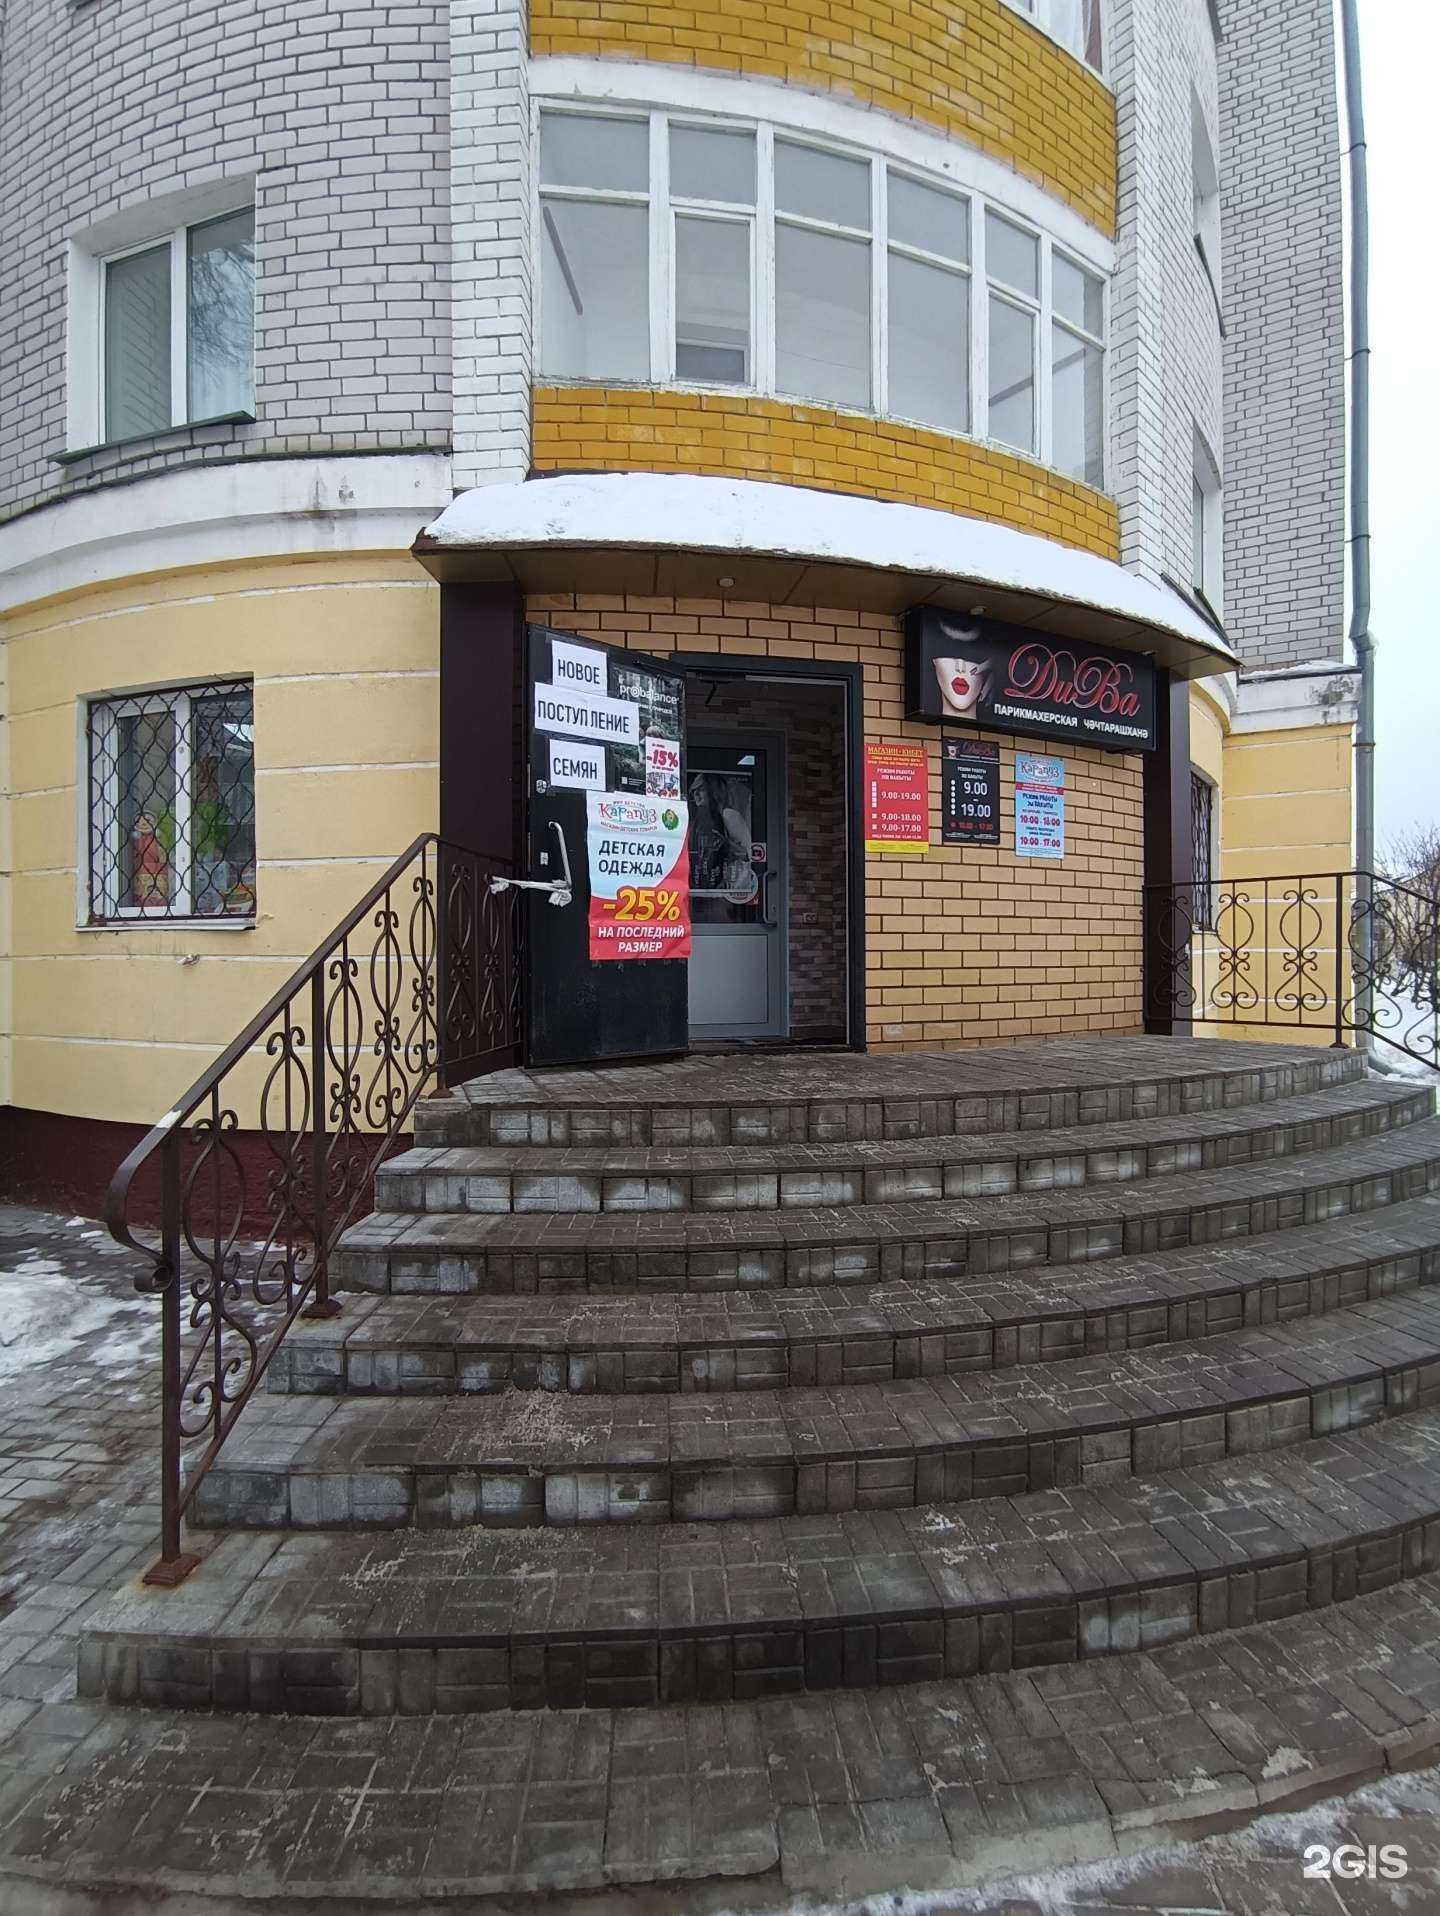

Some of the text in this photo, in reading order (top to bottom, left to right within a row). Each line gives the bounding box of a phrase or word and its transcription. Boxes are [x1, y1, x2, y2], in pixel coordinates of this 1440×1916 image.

[557, 658, 601, 685] НОВОЕ
[537, 700, 630, 734] ПОСТУПЛЕНИЕ
[994, 703, 1078, 728] ПАРИКМАХЕРСКАЯ
[646, 749, 679, 768] -15%
[553, 757, 598, 780] СЕМЯН
[881, 791, 921, 801] 9.00-19.00
[963, 781, 988, 796] 9.00
[961, 803, 991, 818] 19.00
[881, 823, 921, 833] 9.00-17.00
[598, 840, 665, 858] ДЕТСКАЯ
[598, 859, 664, 877] ОДЕЖДА
[602, 887, 681, 922] -25%
[598, 924, 685, 940] НА ПОСЛЕДНИЙ
[617, 941, 663, 953] РАЗМЕР
